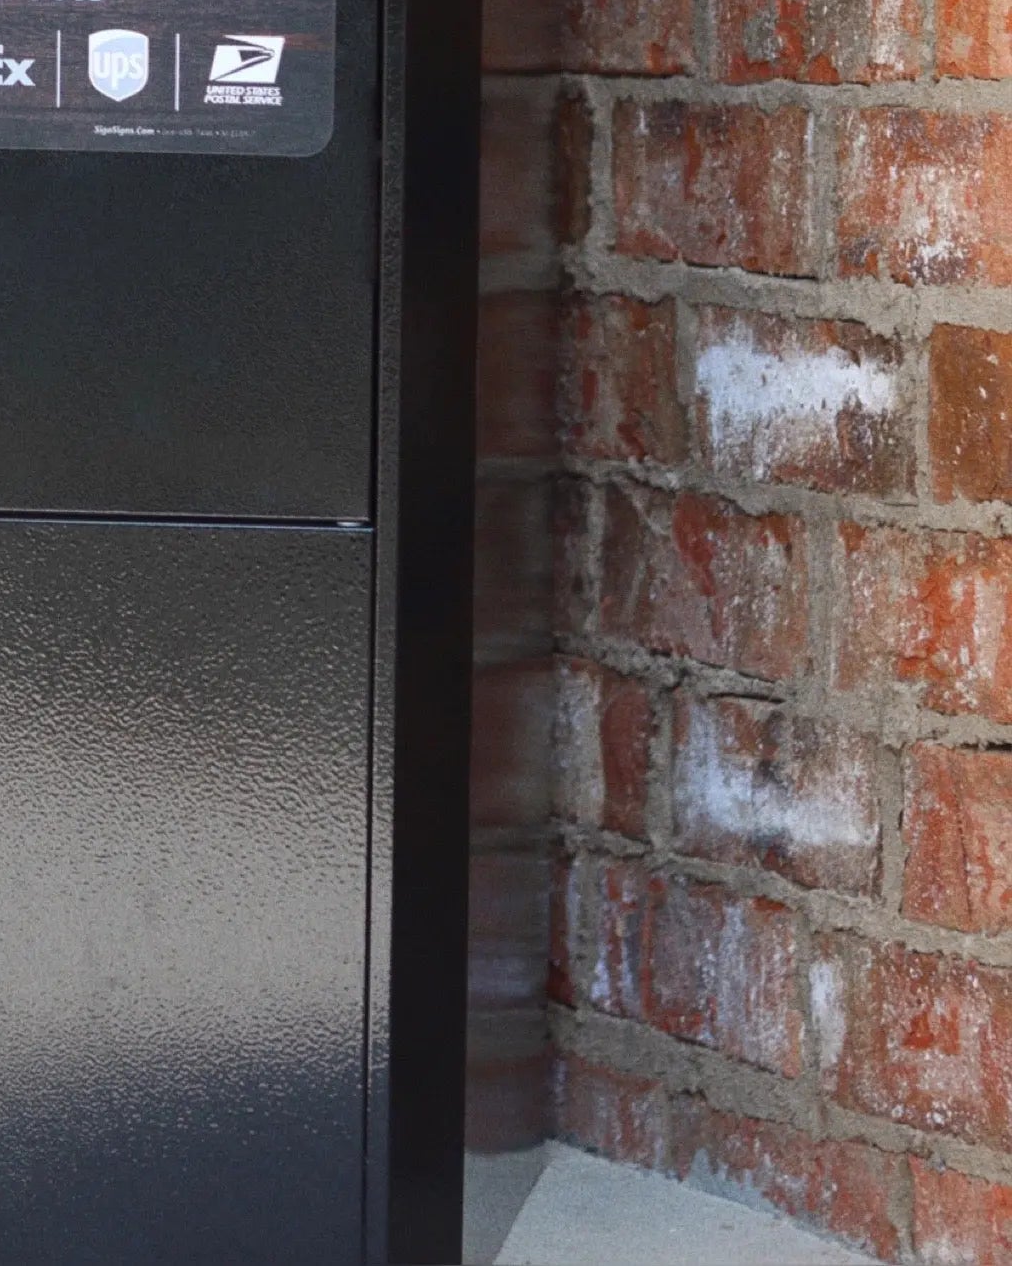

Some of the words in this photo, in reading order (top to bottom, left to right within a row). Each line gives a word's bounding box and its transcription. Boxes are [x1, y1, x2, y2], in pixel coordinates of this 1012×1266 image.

[94, 51, 144, 91] ups
[206, 85, 245, 96] UNITED
[244, 86, 281, 97] STATES
[203, 94, 241, 104] POSTAL
[242, 95, 283, 107] SERVICE
